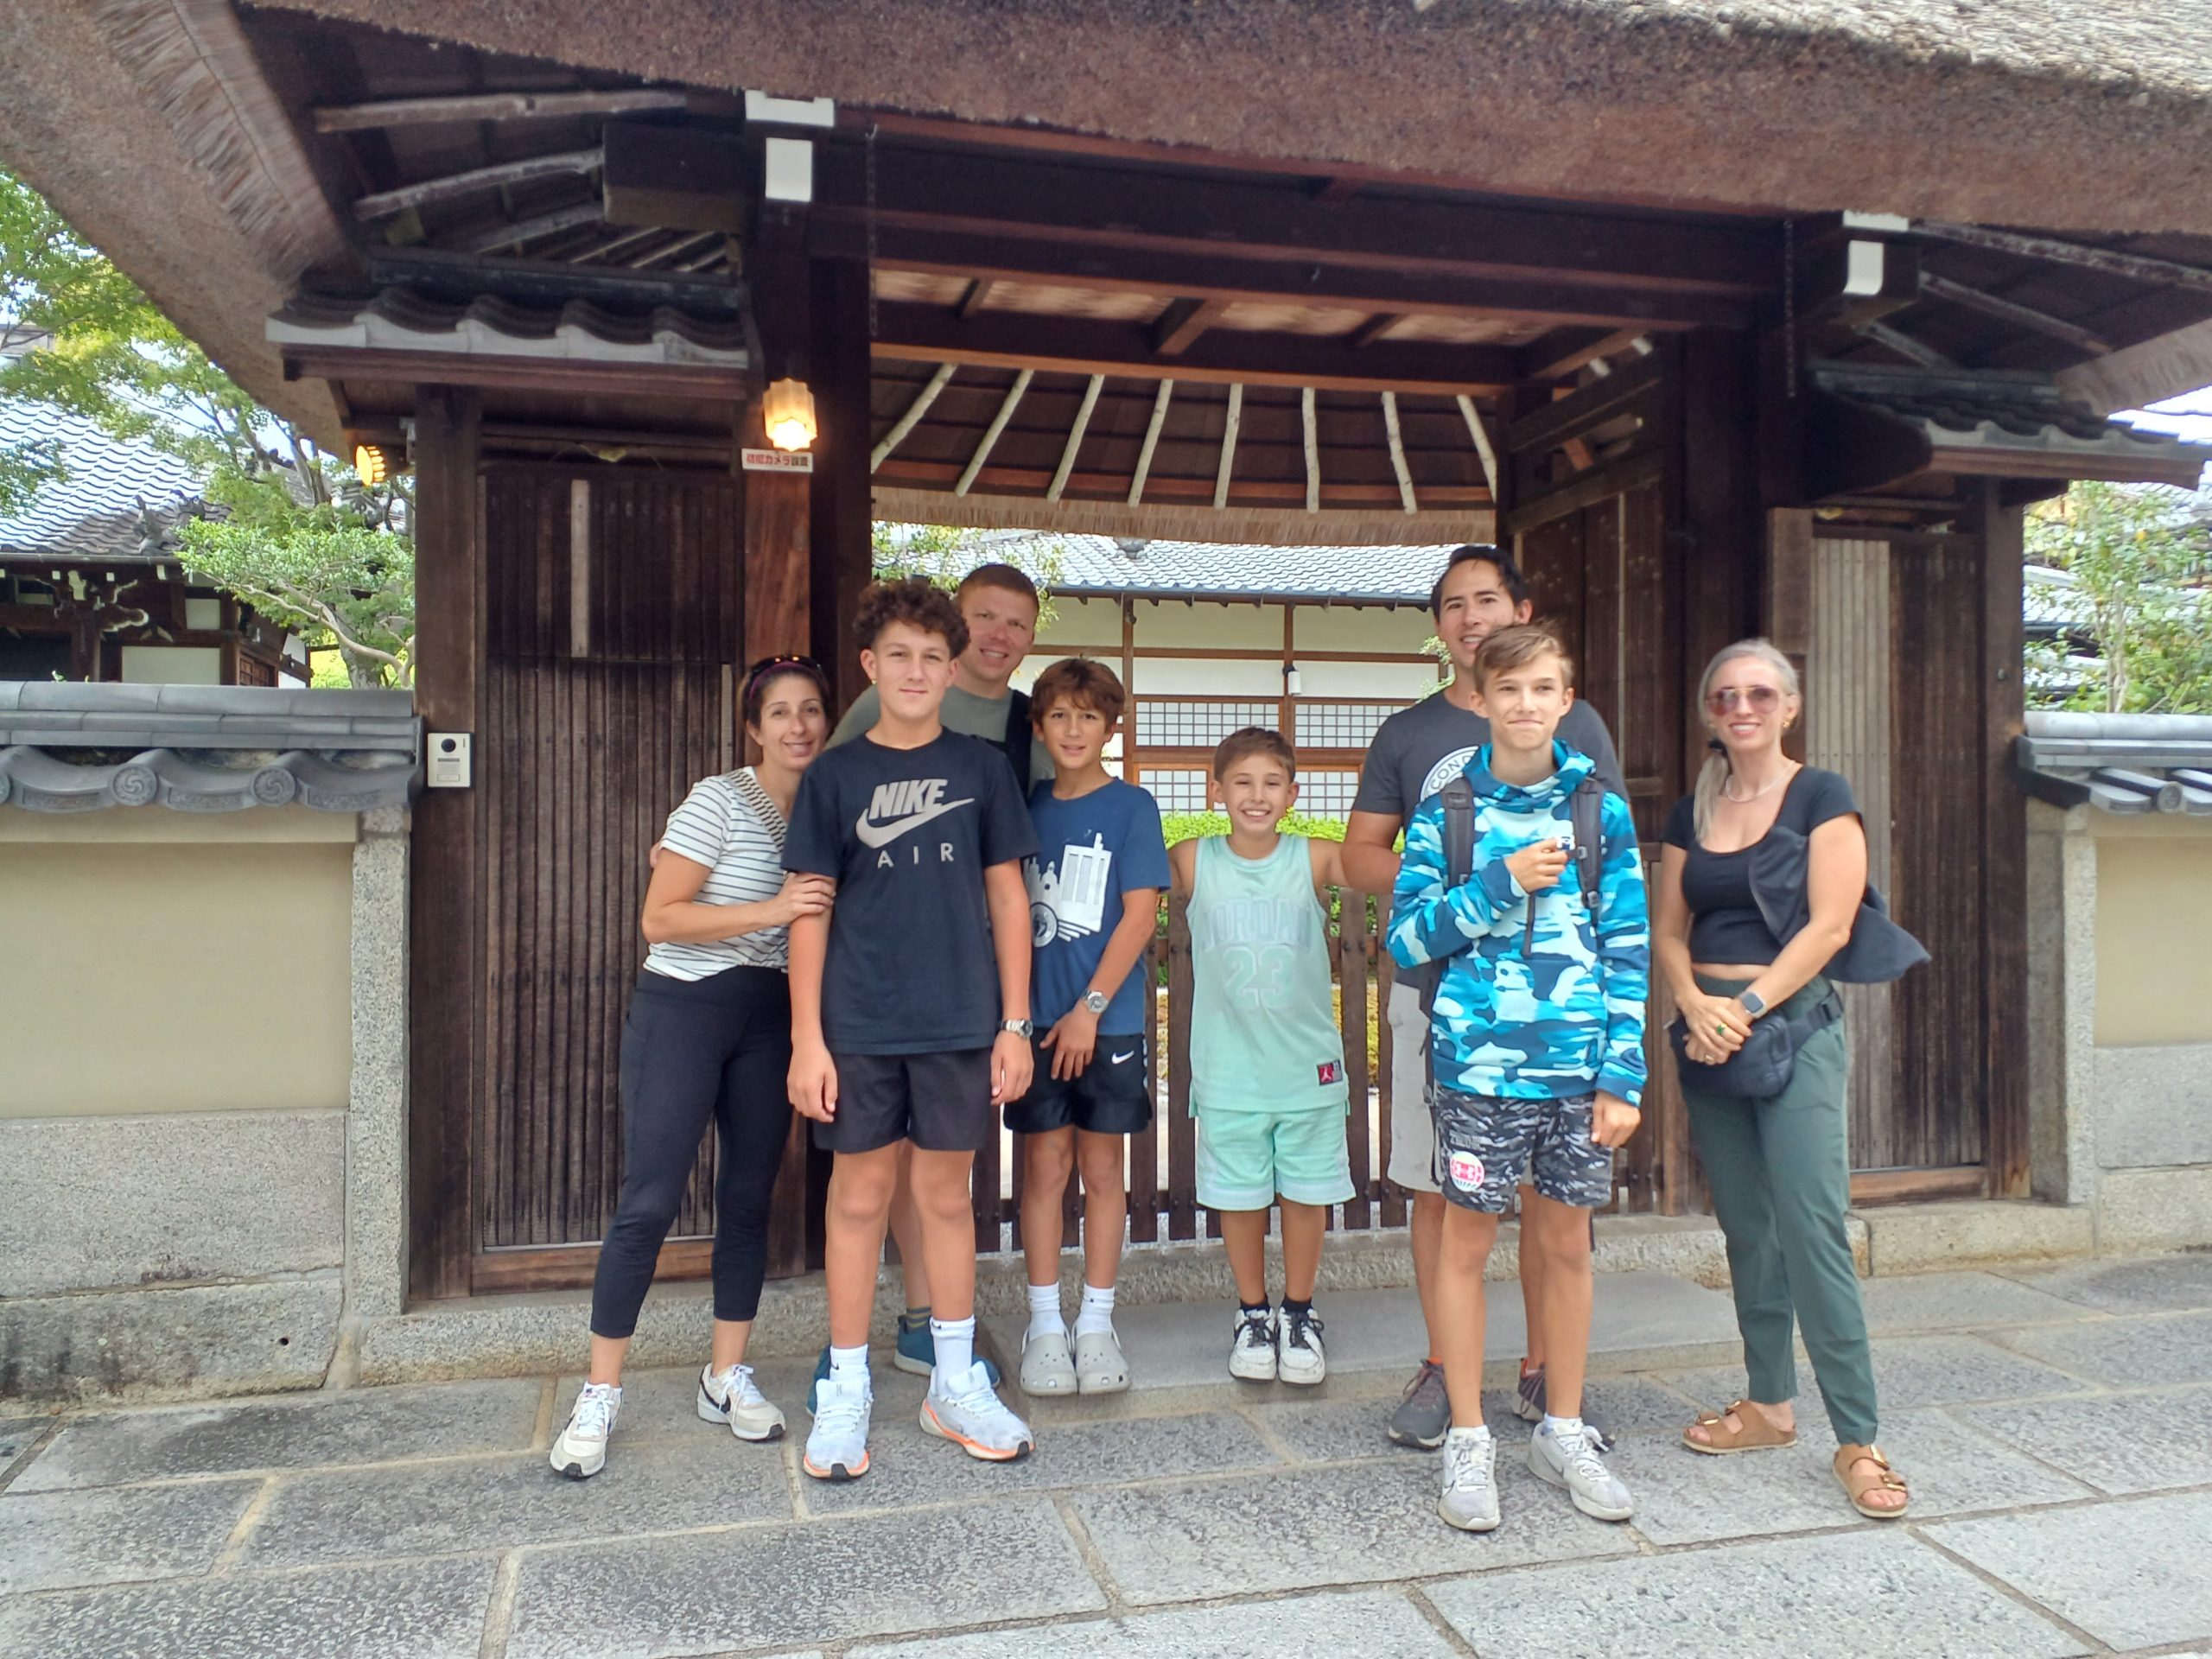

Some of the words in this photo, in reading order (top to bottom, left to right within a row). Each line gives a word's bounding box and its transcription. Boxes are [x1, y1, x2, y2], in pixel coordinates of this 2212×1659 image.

[868, 779, 948, 820] NIKE
[877, 842, 954, 868] AIR
[1223, 944, 1294, 1009] 23
